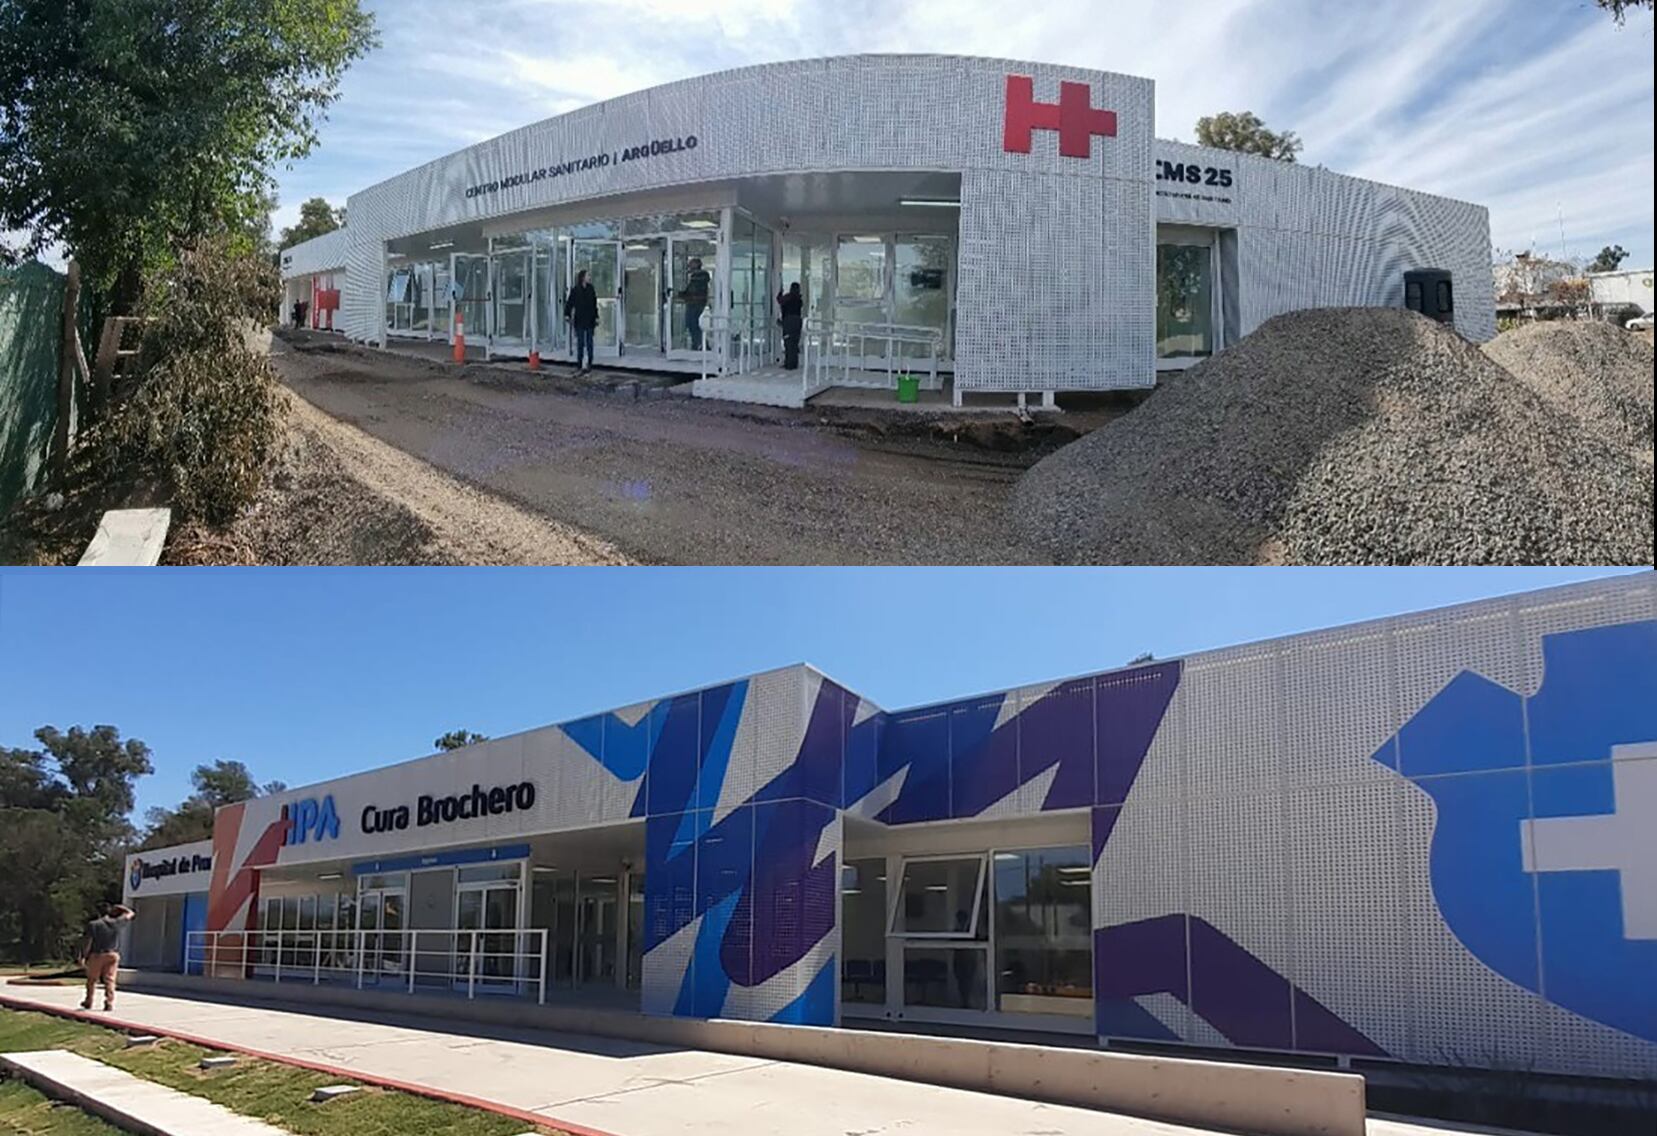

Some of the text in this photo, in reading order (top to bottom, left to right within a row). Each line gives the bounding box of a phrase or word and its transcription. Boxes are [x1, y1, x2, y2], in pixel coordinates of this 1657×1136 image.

[466, 182, 499, 198] CENTRO
[500, 168, 547, 191] MODULAR
[548, 153, 609, 178] SANITARIO
[1204, 167, 1233, 187] 25
[279, 794, 340, 846] HPA
[361, 781, 536, 834] Cura Brochero
[142, 857, 177, 881] Hospital
[178, 856, 190, 874] de
